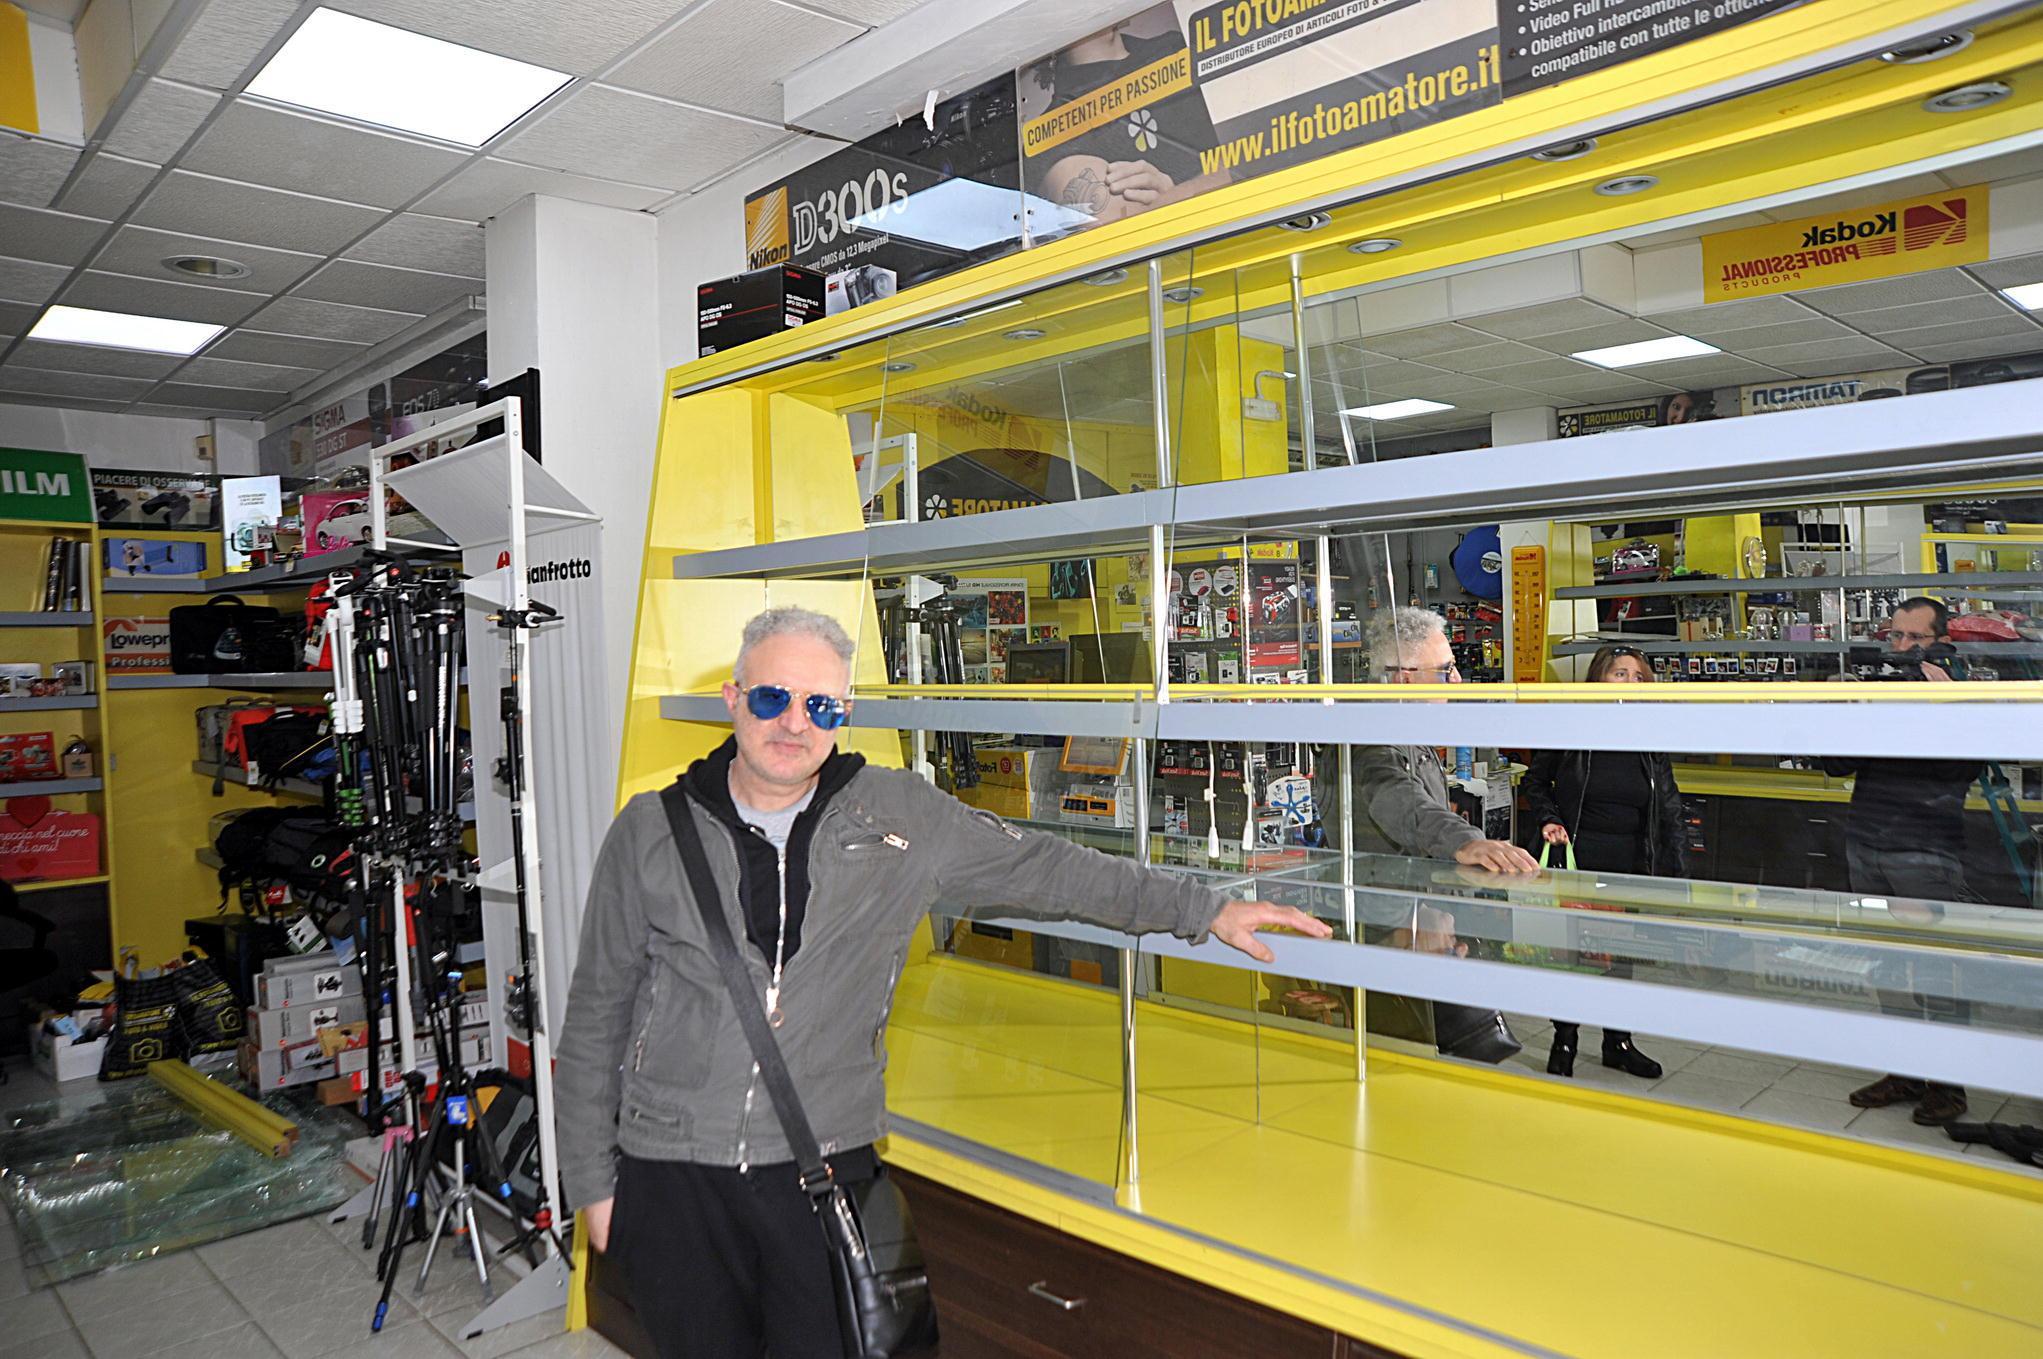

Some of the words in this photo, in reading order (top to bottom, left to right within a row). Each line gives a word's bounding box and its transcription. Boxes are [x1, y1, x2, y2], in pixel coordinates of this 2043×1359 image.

[1530, 11, 1570, 34] Video
[1573, 0, 1601, 19] Full
[1195, 17, 1217, 53] IL
[1201, 43, 1255, 72] DISTRIBUTORE
[1257, 29, 1293, 49] EUROPEO
[1295, 25, 1305, 35] DI
[1306, 9, 1345, 31] ARTICOLI
[1530, 24, 1595, 56] Obiettivo
[1531, 38, 1617, 78] compatibile
[1620, 29, 1649, 50] con
[1652, 15, 1691, 39] tutte
[1694, 8, 1710, 26] le
[1027, 104, 1097, 147] COMPETENTI
[1100, 85, 1122, 113] PER
[1127, 57, 1187, 99] PASSIONE
[1199, 44, 1500, 176] www.ilfotoamatore.it
[749, 243, 788, 270] Nikon
[821, 251, 838, 268] CMOS
[838, 252, 846, 262] da
[858, 232, 889, 254] Megapixel
[314, 404, 346, 435] SIGMA
[94, 474, 138, 487] PIACERE
[140, 475, 152, 487] DI
[111, 633, 171, 650] Lowepr
[111, 656, 171, 668] Professi
